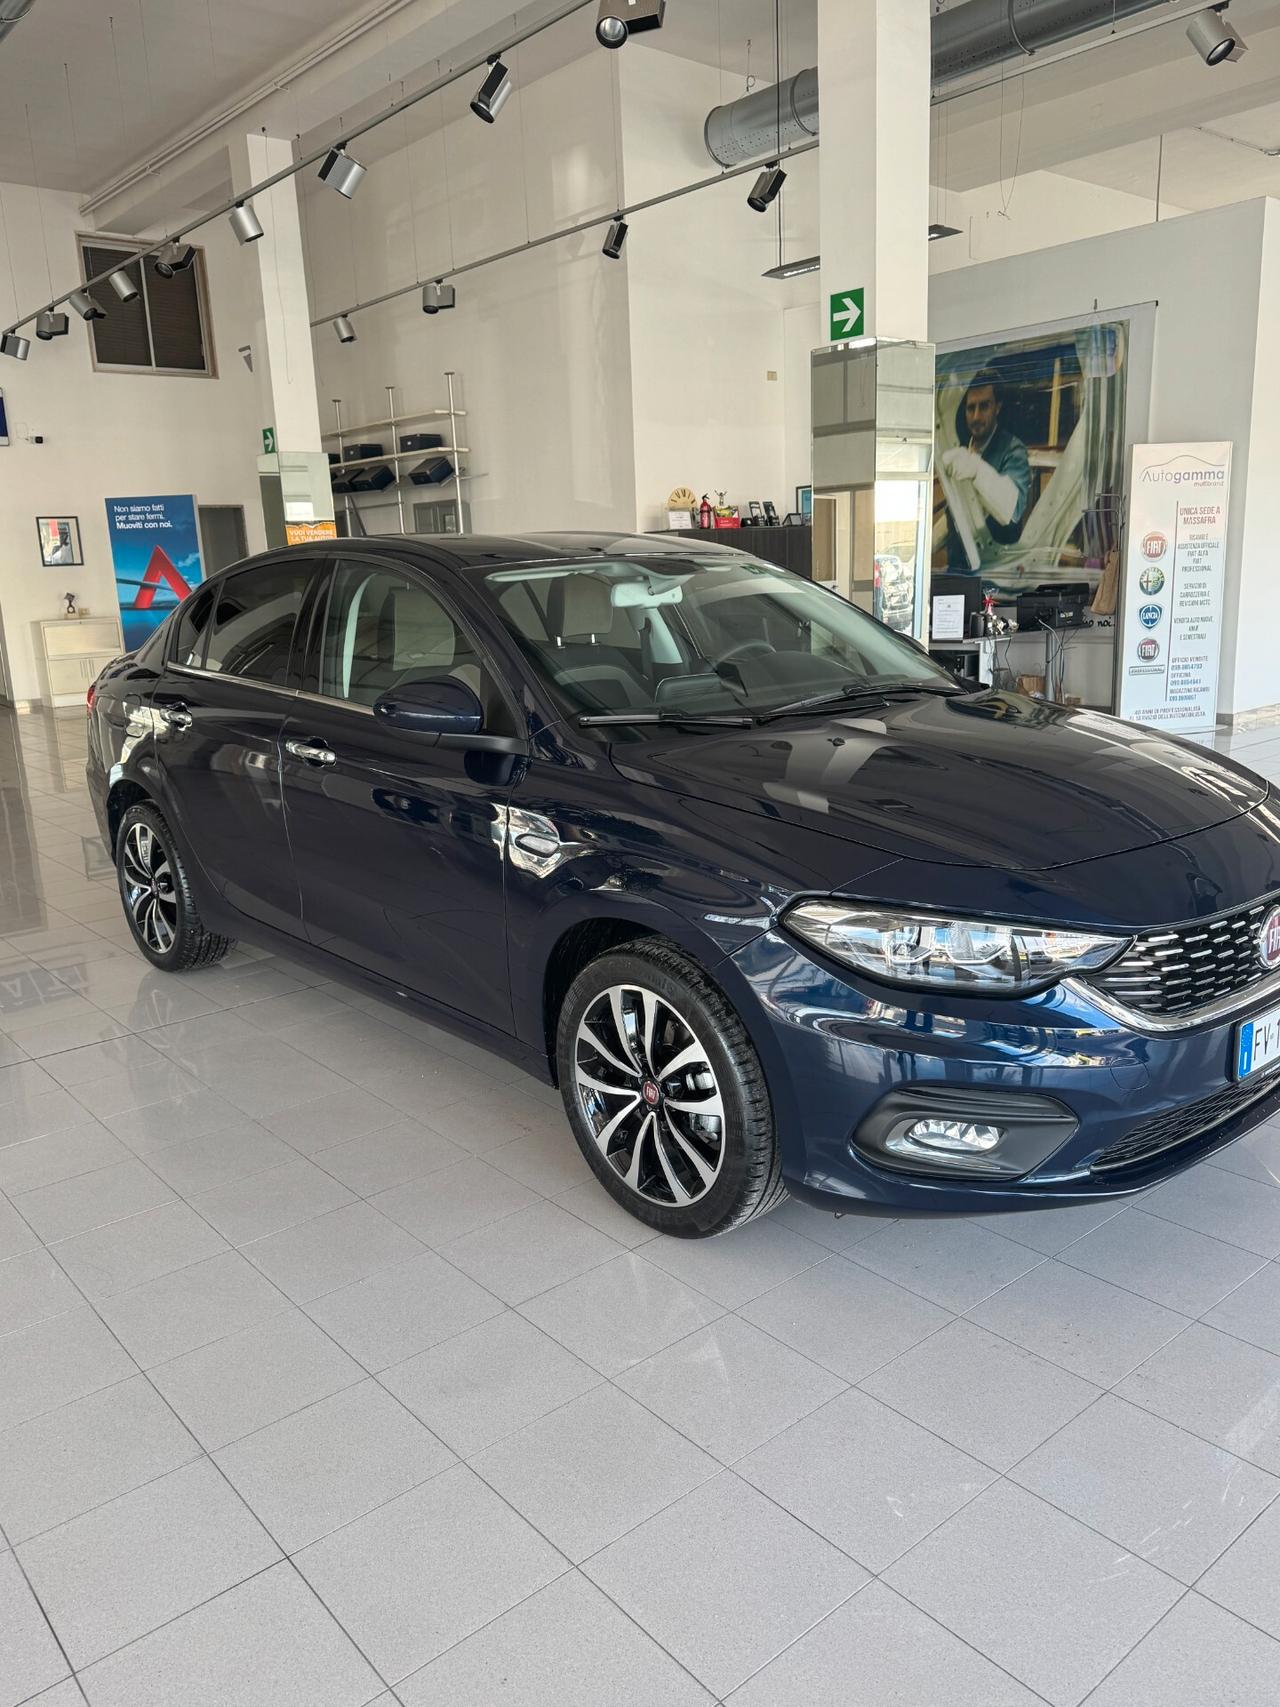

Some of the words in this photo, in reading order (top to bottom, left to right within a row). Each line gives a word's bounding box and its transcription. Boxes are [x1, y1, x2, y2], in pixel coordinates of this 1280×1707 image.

[1142, 470, 1224, 484] Autogamma
[113, 505, 129, 513] Non
[130, 504, 151, 512] siamo
[151, 503, 165, 511] fatti
[1179, 506, 1198, 516] UNICA
[1199, 506, 1215, 515] SEDE
[1215, 505, 1221, 514] A
[115, 514, 127, 522] per
[128, 513, 146, 521] stare
[146, 512, 165, 520] fermi.
[1183, 515, 1216, 525] MASSAFRA
[116, 521, 143, 529] Muoviti
[159, 520, 173, 528] noi.
[1146, 540, 1163, 554] FIAT
[1142, 611, 1158, 619] LANCIA
[1141, 644, 1155, 657] FIAT
